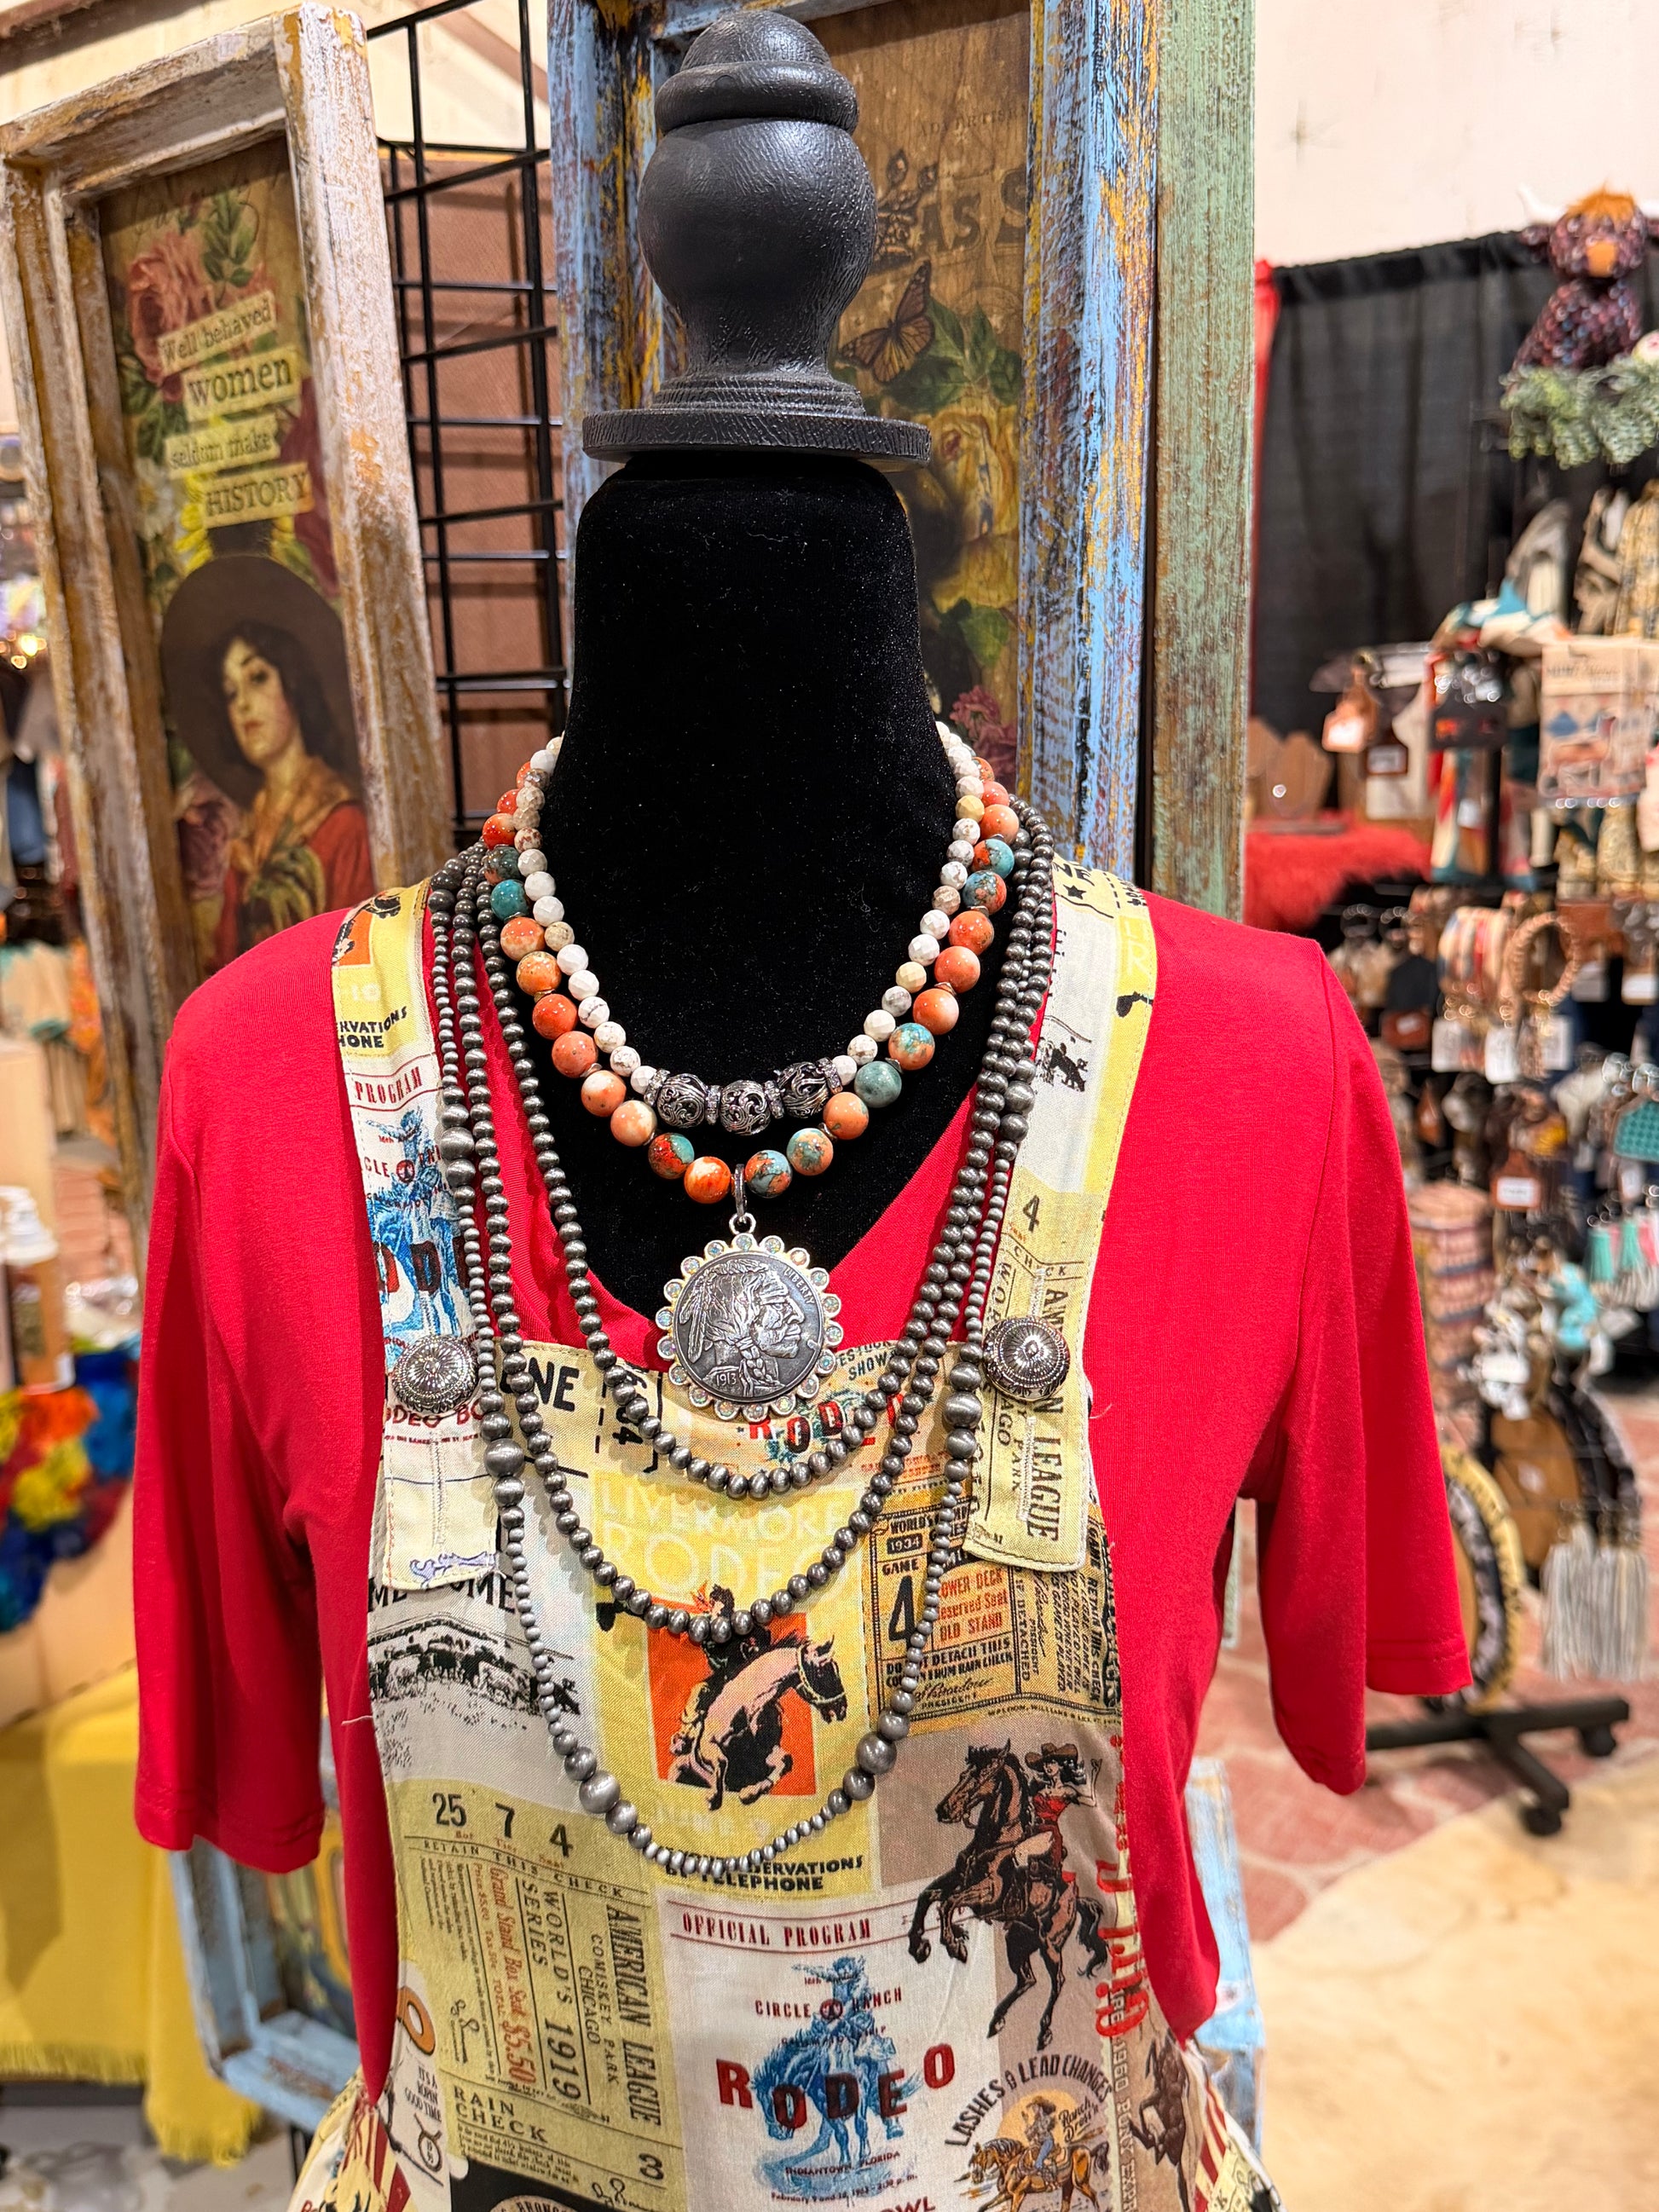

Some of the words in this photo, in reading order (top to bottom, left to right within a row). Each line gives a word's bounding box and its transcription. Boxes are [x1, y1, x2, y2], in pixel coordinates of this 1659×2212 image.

[160, 330, 199, 364] Well
[202, 300, 273, 349] behaved
[188, 356, 293, 407] women
[205, 474, 308, 517] HISTORY
[354, 1066, 424, 1104] PROGRAM
[1021, 1194, 1040, 1233] 4
[783, 1266, 816, 1305] LIBERTY
[715, 1373, 737, 1386] 1913
[847, 1354, 887, 1381] SHOW
[1026, 1435, 1062, 1542] LEAGUE
[889, 1535, 922, 1552] 1934
[882, 1558, 920, 1576] GAME
[939, 1575, 971, 1598] OWER
[975, 1568, 1004, 1591] DECK
[887, 1574, 917, 1649] 4
[939, 1597, 981, 1620] eserved
[939, 1621, 962, 1643] OLD
[968, 1612, 1003, 1634] STAND
[931, 1644, 978, 1666] DETACH
[981, 1637, 1011, 1655] THIS
[981, 1651, 1014, 1668] CHECK
[1017, 1599, 1031, 1682] DETACHED
[431, 1792, 468, 1827] 25
[494, 1802, 516, 1839] 7
[549, 1822, 575, 1859] 4
[423, 1840, 481, 1856] RETAIN
[493, 1851, 540, 1875] THIS
[552, 1872, 624, 1898] CHECK
[489, 1866, 515, 1910] Grand
[497, 1911, 522, 1954] Stand
[522, 1879, 548, 1967] SERIES
[682, 1913, 771, 1946] OFFICIAL
[783, 1918, 871, 1948] PROGRAM
[543, 1890, 573, 2006] WORLD'S
[605, 1903, 652, 2028] AMERICAN
[577, 1965, 601, 2046] CHICAGO
[590, 1933, 612, 2026] COMISKEY
[603, 2039, 620, 2085] PARK
[754, 2000, 811, 2019] CIRCLE
[852, 1986, 902, 2012] RANCH
[502, 2019, 537, 2084] $5.50
[543, 2016, 582, 2102] 1919
[454, 2085, 515, 2117] RAIN
[622, 2037, 662, 2127] LEAGUE
[715, 2042, 956, 2130] RODEO
[944, 2079, 1007, 2148] LASHES
[1018, 2053, 1061, 2083] LEAD
[1061, 2053, 1113, 2104] CHANGES
[455, 2103, 548, 2144] CHECK
[1058, 2094, 1094, 2129] Ranch
[1115, 2097, 1135, 2157] PONY
[639, 2153, 665, 2180] 3
